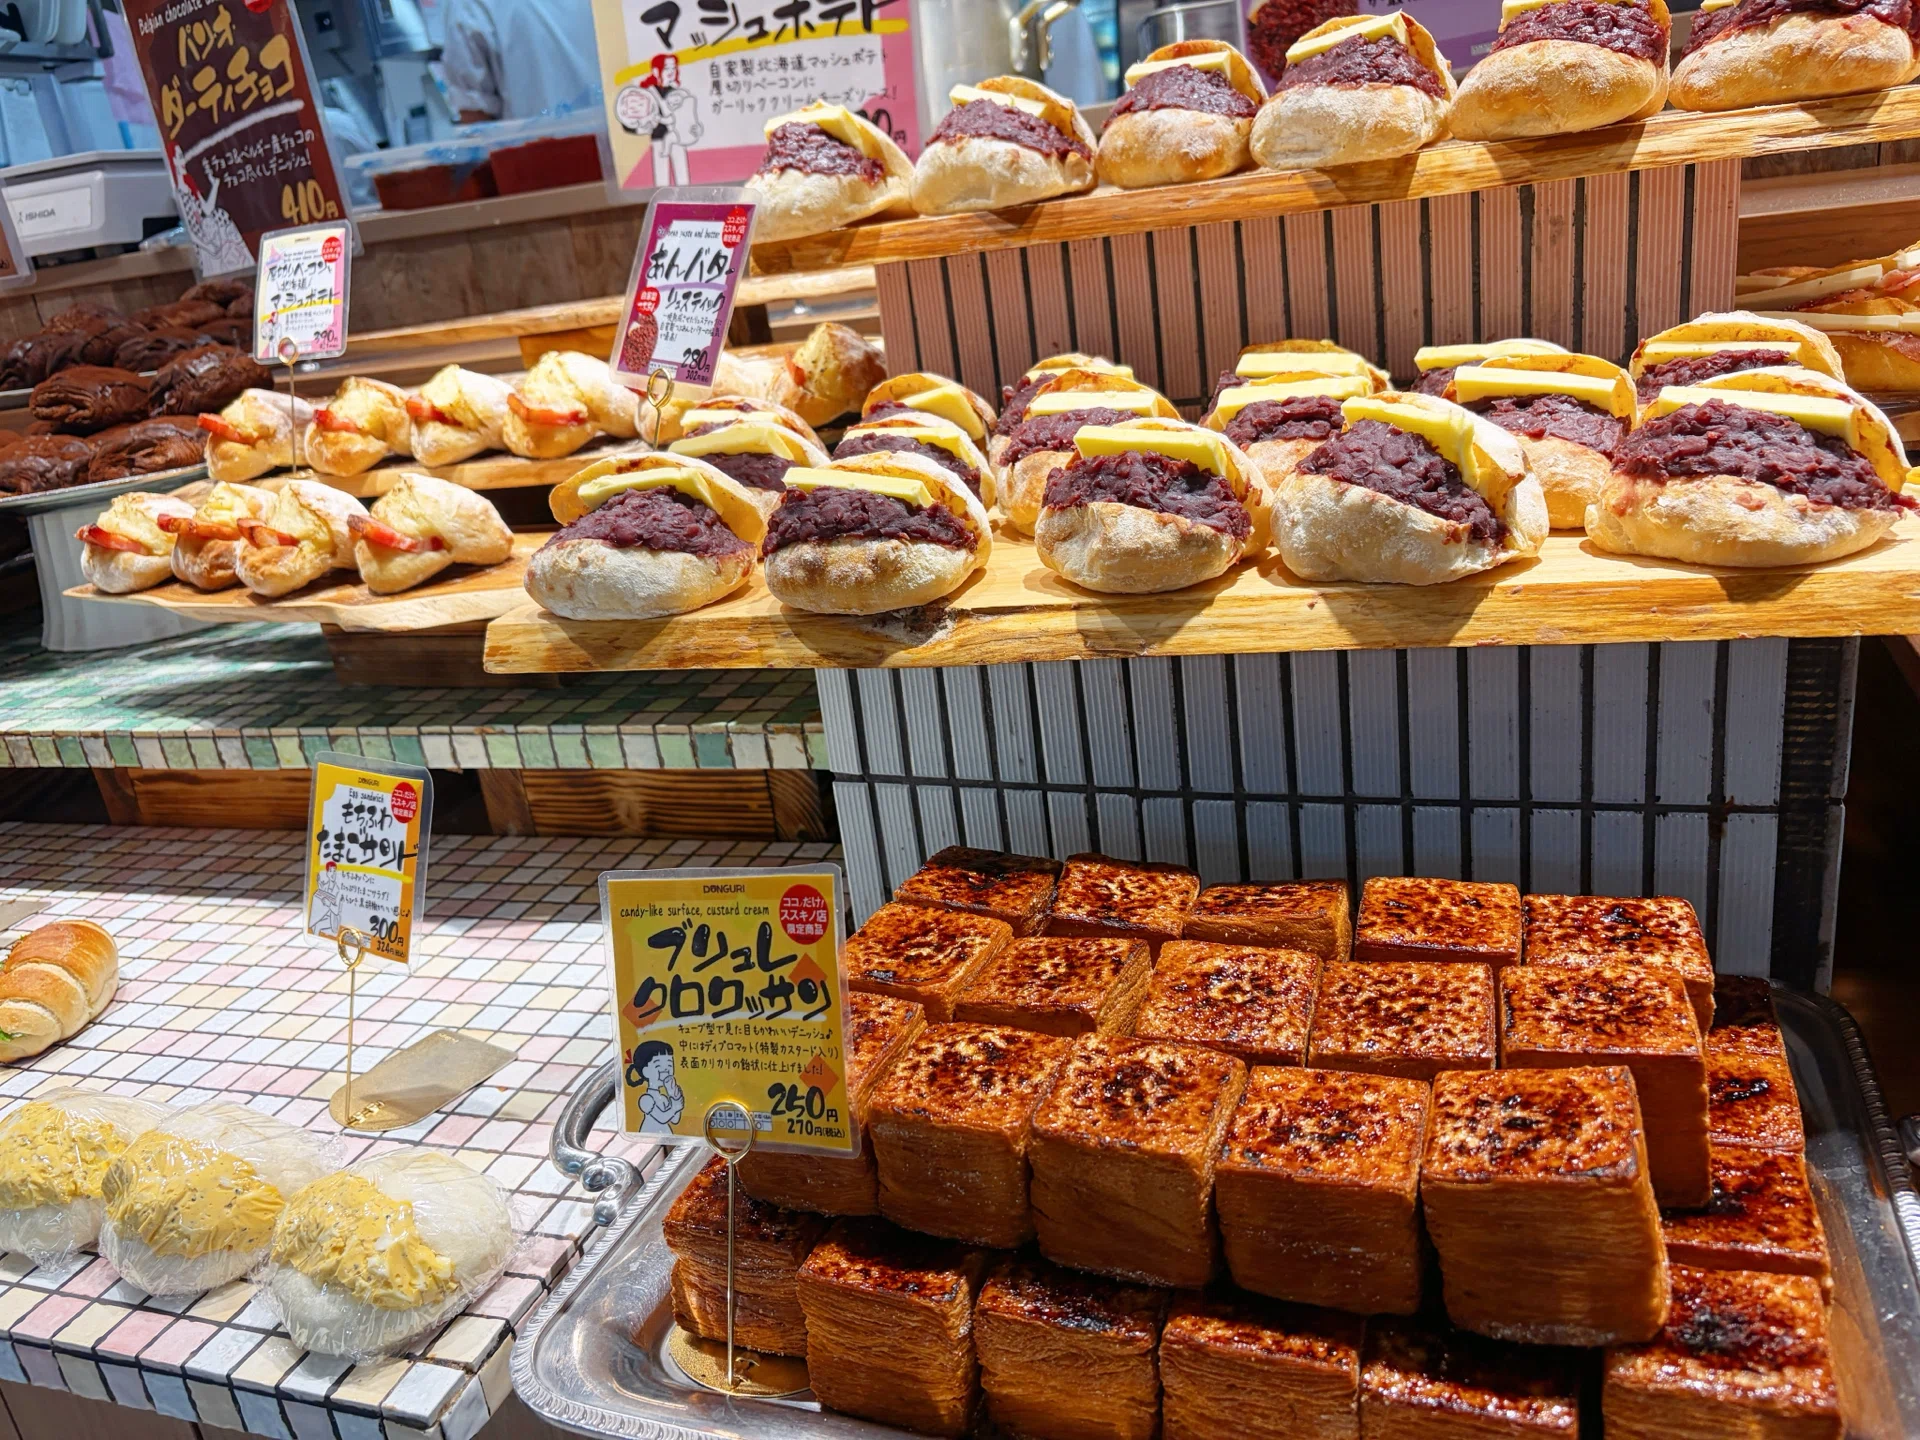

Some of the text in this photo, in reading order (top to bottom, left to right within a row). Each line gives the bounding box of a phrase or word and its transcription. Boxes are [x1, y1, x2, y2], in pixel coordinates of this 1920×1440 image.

[138, 14, 164, 36] Belgian
[161, 34, 295, 139] ダーティチョコ
[25, 208, 56, 221] ISHIDA
[646, 242, 735, 283] あんバター
[665, 287, 726, 313] リュスティック
[349, 788, 385, 803] Egg sandwich
[341, 798, 393, 831] もちふわ
[317, 824, 419, 871] たまごサンド
[703, 885, 745, 894] DONGURI
[620, 902, 770, 918] candy-like surface, custard cream
[781, 909, 827, 922] ススキノ店
[369, 915, 404, 947] 300円
[787, 923, 823, 935] 限定商品
[647, 918, 798, 973] ブリュレ
[633, 973, 832, 1021] クロワッサン
[768, 1082, 839, 1122] 250円
